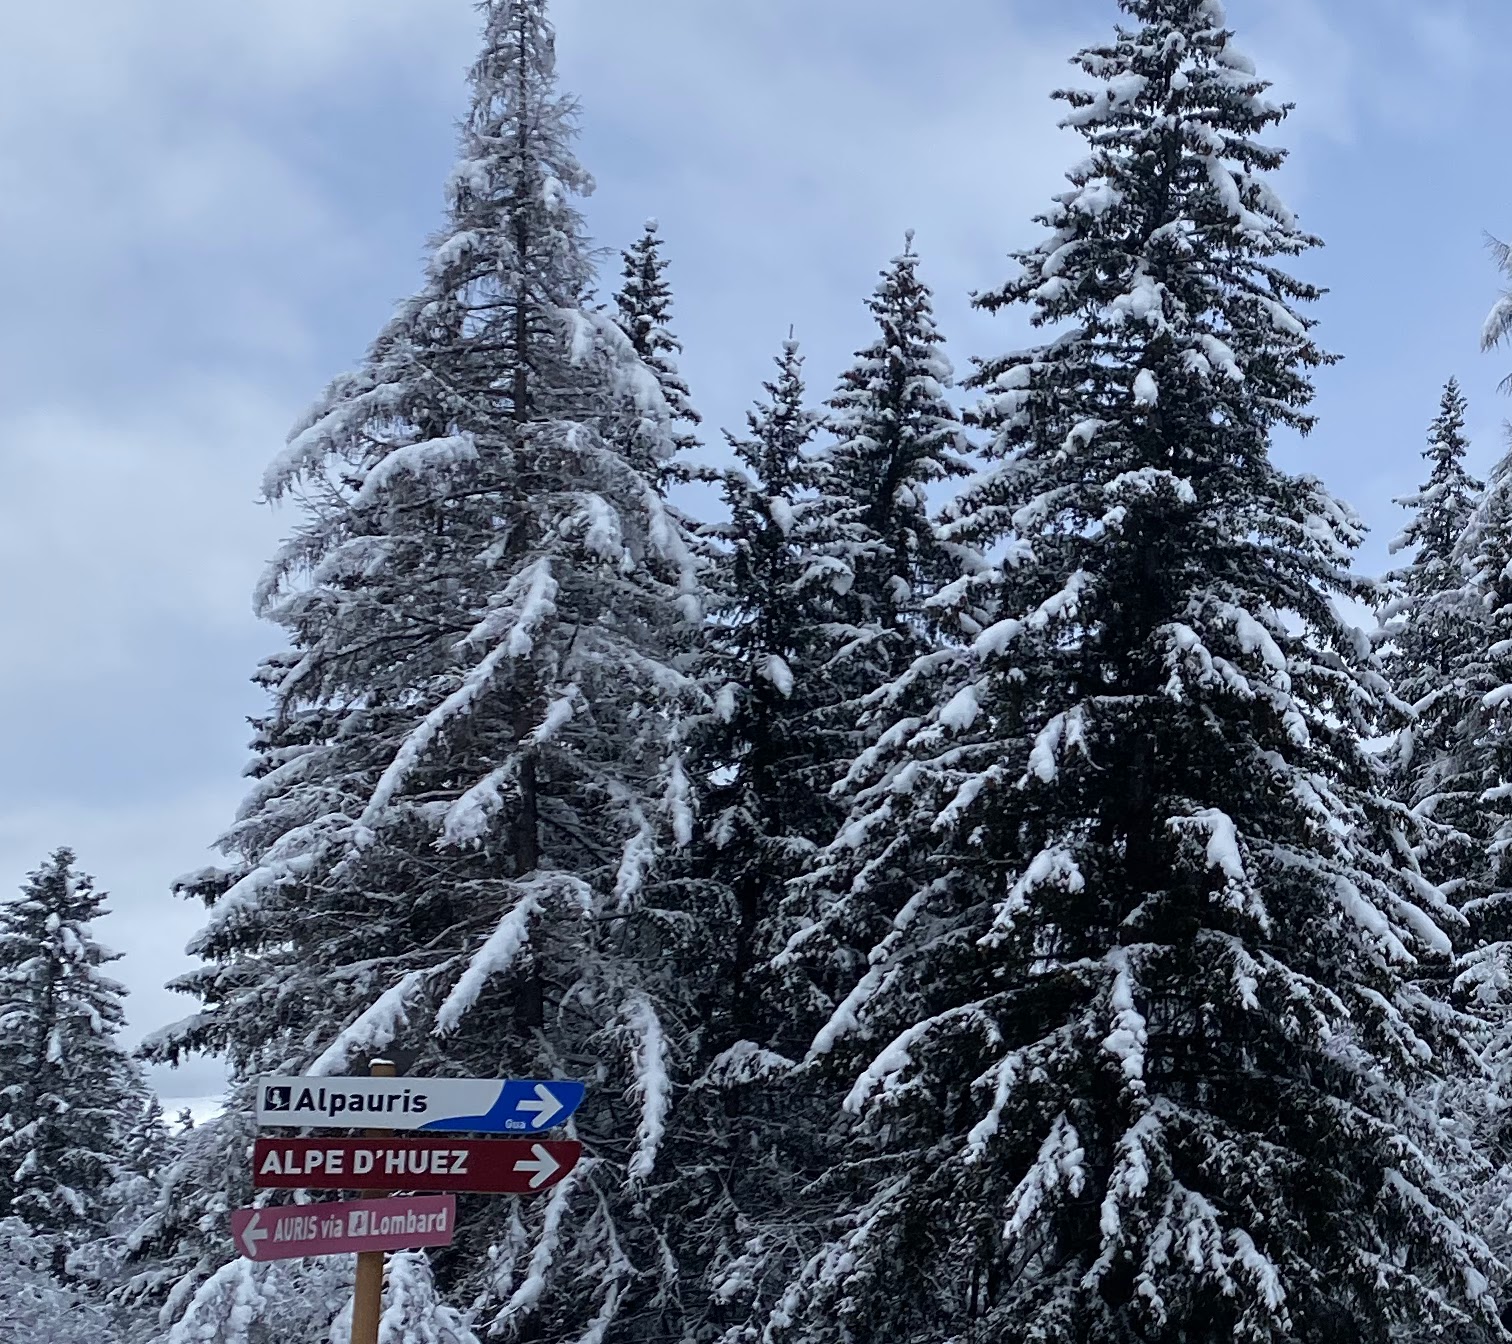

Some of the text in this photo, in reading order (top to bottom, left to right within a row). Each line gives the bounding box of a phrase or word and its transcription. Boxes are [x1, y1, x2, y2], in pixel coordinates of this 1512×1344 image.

[294, 1088, 428, 1117] Alpauris
[259, 1149, 469, 1174] ALPE D'HUEZ
[273, 1207, 447, 1243] AURIS via Lombard
